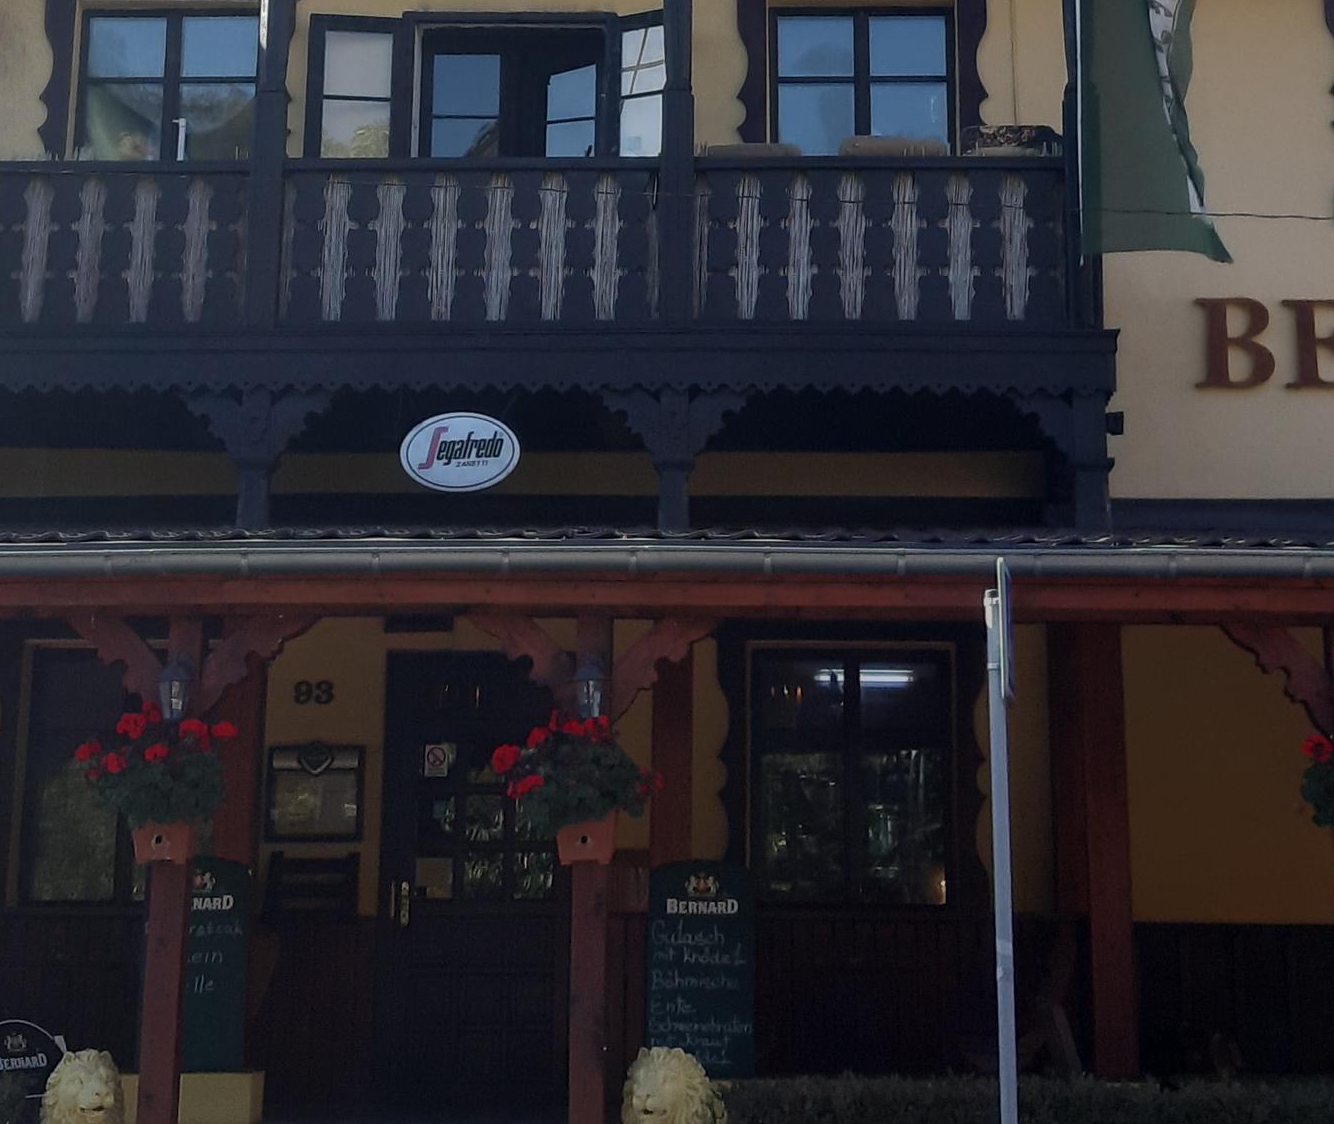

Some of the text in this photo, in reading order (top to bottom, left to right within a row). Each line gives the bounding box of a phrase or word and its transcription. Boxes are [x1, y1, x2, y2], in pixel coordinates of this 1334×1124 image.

[417, 426, 505, 471] Segafredo
[294, 680, 334, 705] 93
[192, 894, 234, 911] NARD
[666, 898, 739, 915] BERNARD
